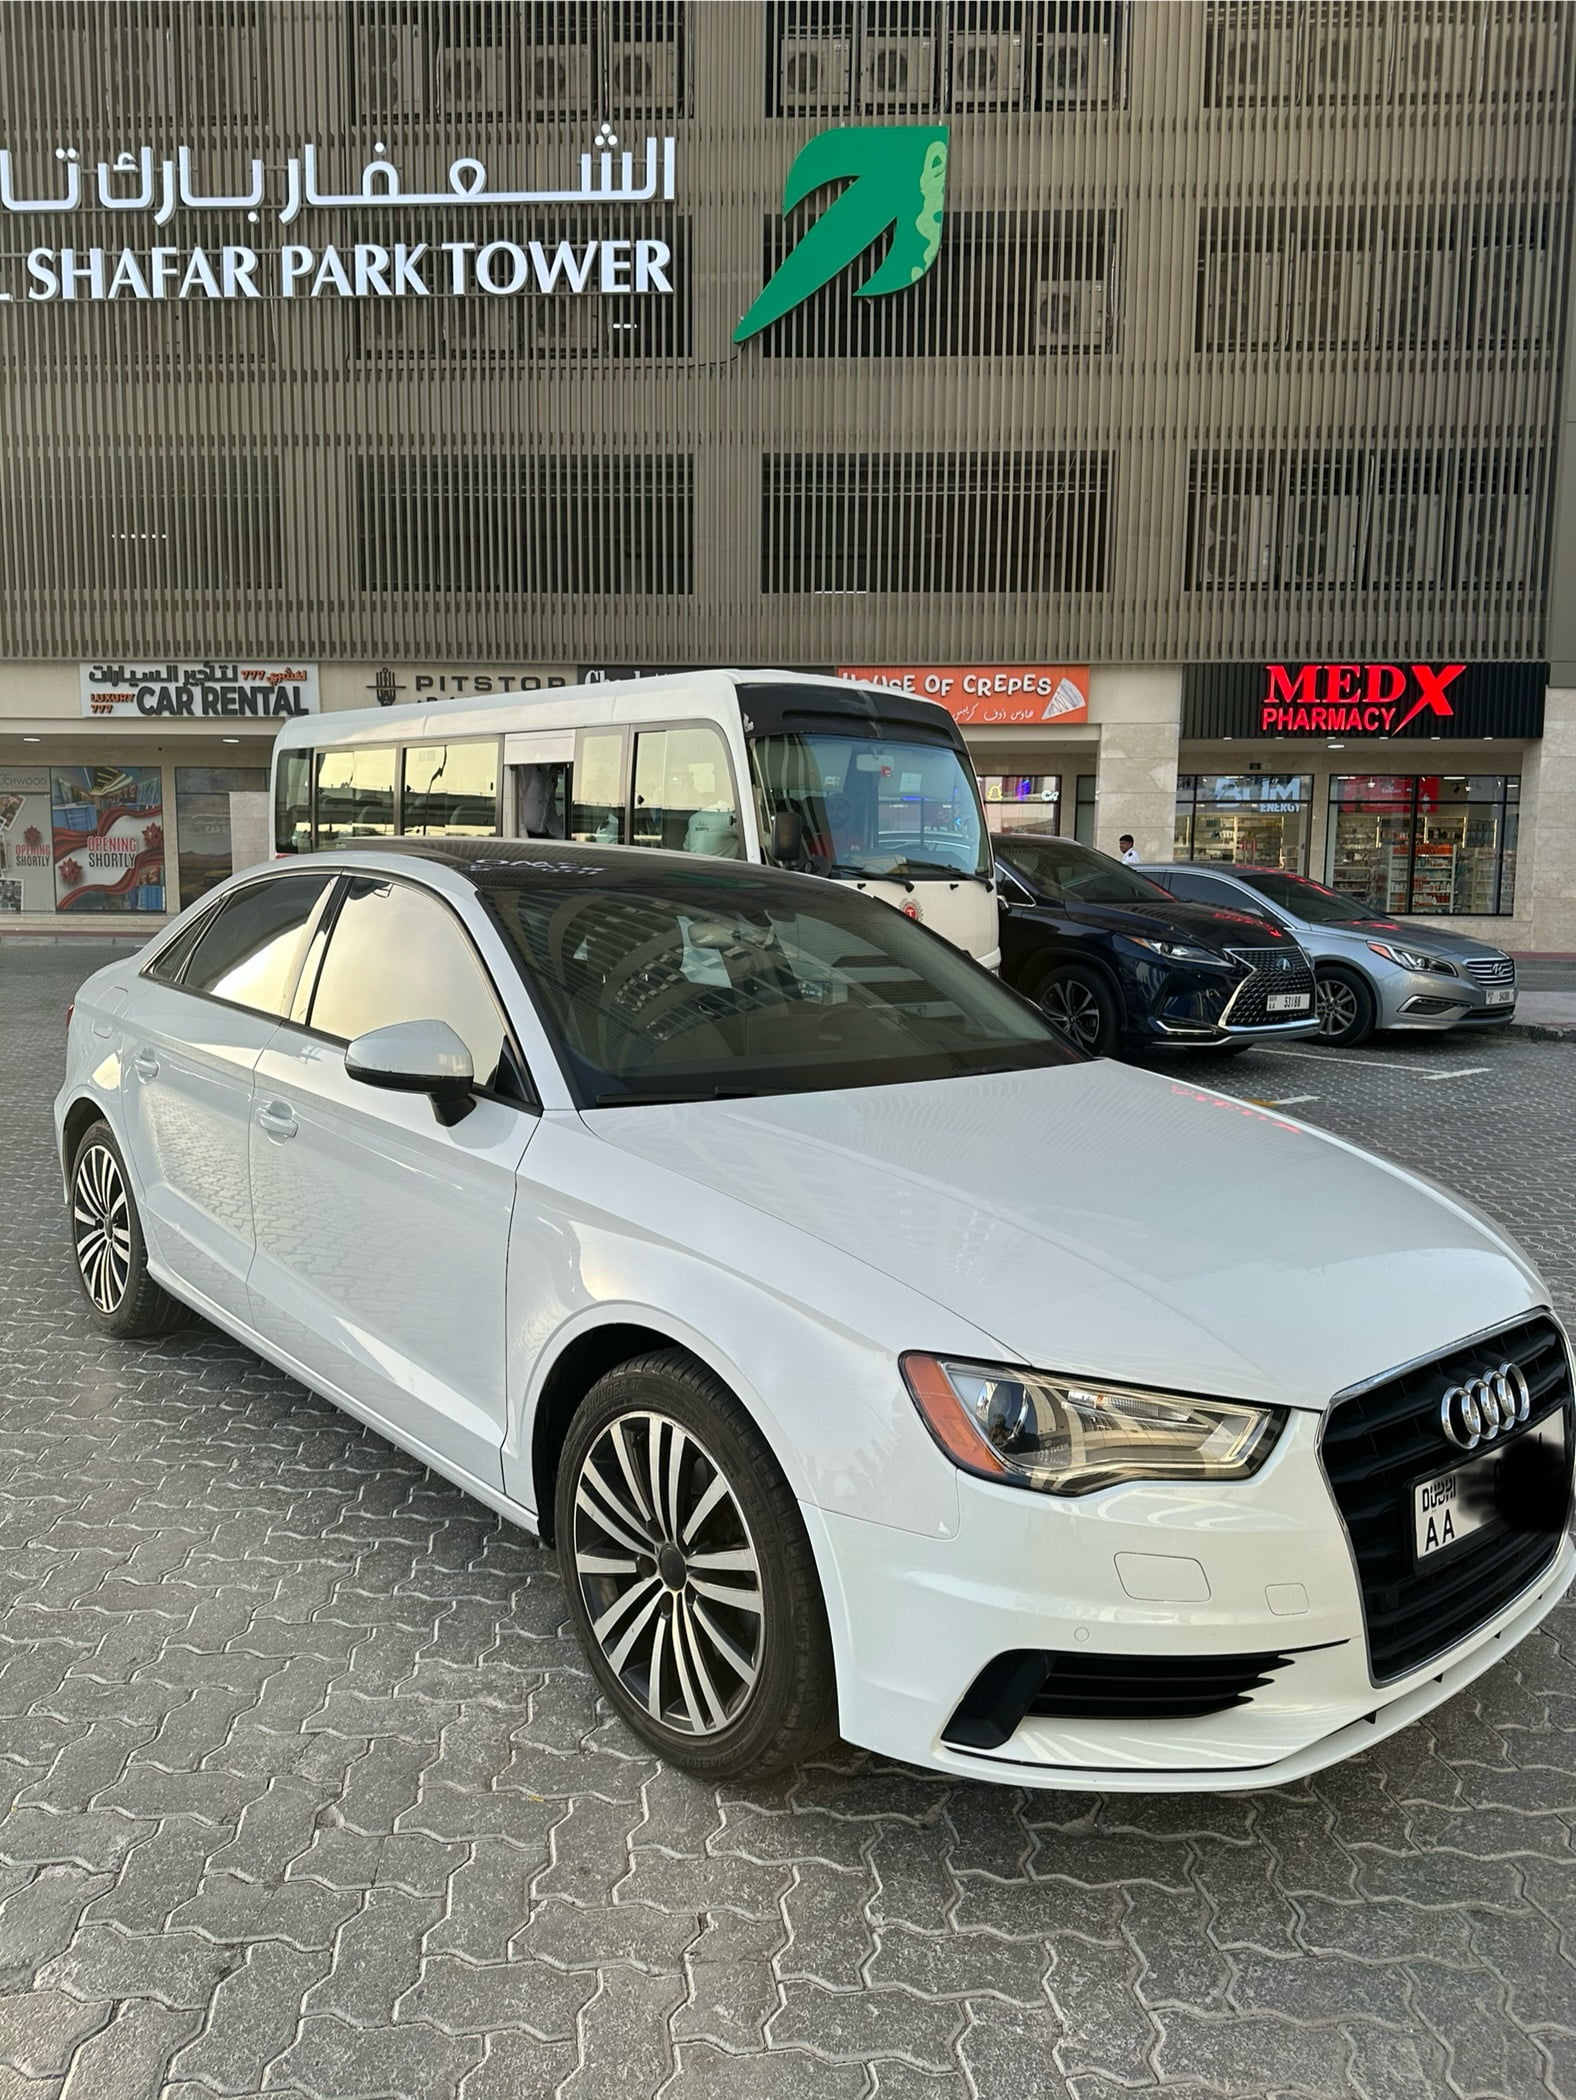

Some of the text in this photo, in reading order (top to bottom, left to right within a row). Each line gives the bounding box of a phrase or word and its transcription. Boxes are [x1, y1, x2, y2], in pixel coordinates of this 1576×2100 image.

[97, 145, 264, 227] بارك
[27, 239, 675, 301] SHAFAR PARK TOWER
[924, 674, 954, 697] OF
[963, 673, 1053, 697] CREPES
[90, 693, 135, 703] LUXURY
[136, 686, 310, 716] CAR RENTAL
[1262, 707, 1397, 731] PHARMACY
[1260, 803, 1300, 813] ENERGY
[15, 844, 50, 855] OPENING
[87, 836, 137, 853] OPENING
[16, 855, 50, 867] SHORTLY
[88, 853, 136, 869] SHORTLY
[1425, 1509, 1455, 1552] AA
